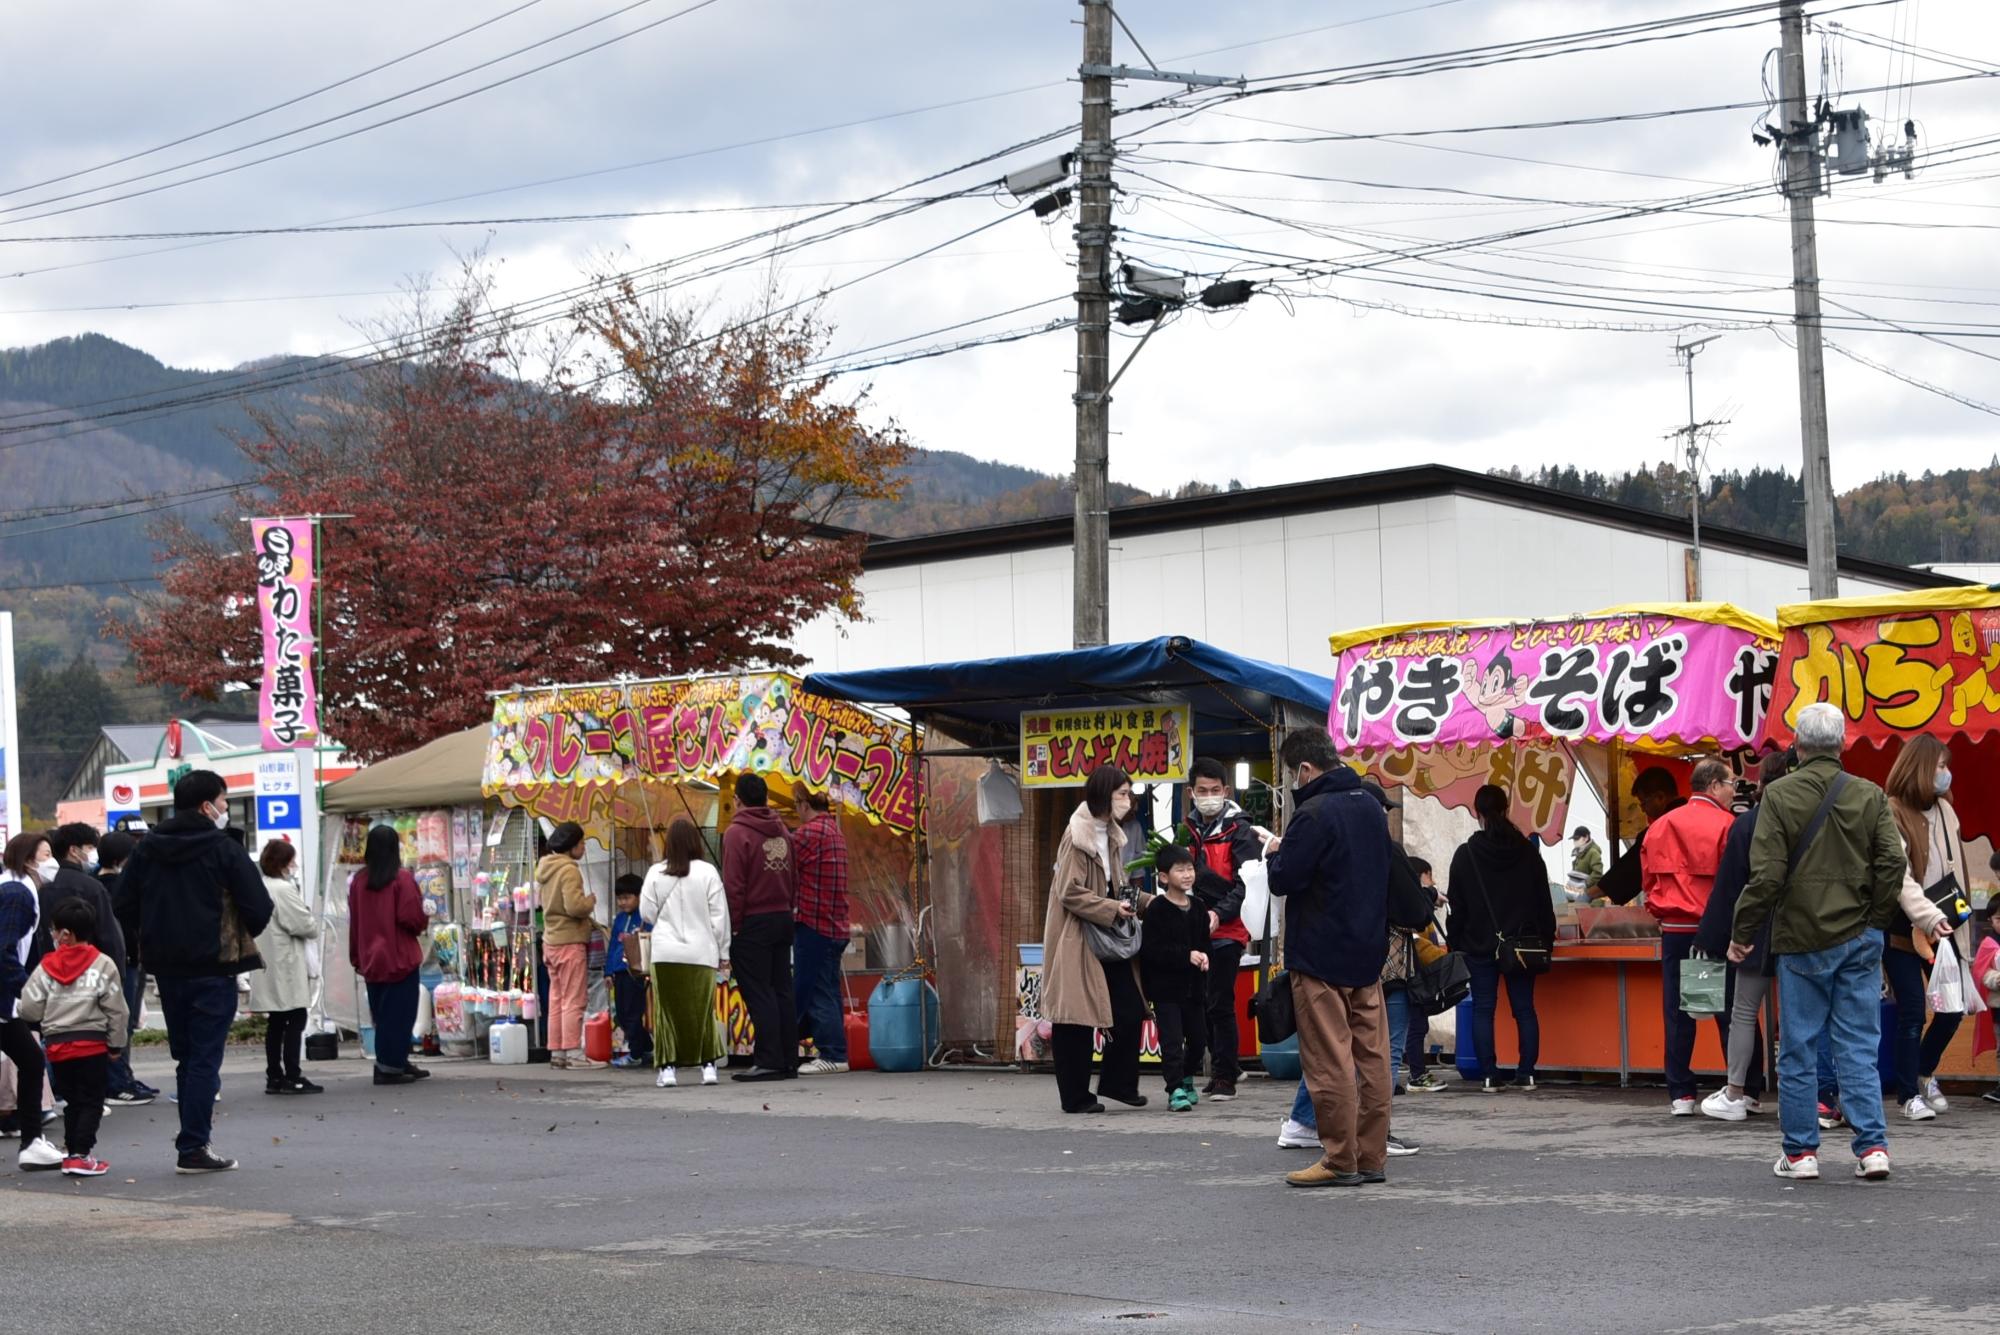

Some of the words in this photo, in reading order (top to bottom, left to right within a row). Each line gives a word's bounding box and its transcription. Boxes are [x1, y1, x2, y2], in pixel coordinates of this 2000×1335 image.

[271, 578, 307, 745] わた菓子
[1340, 656, 1463, 743] やき
[1528, 634, 1687, 735] そば
[523, 701, 739, 780] クレープ屋さん
[1048, 730, 1169, 779] どんどん焼
[267, 800, 290, 825] P
